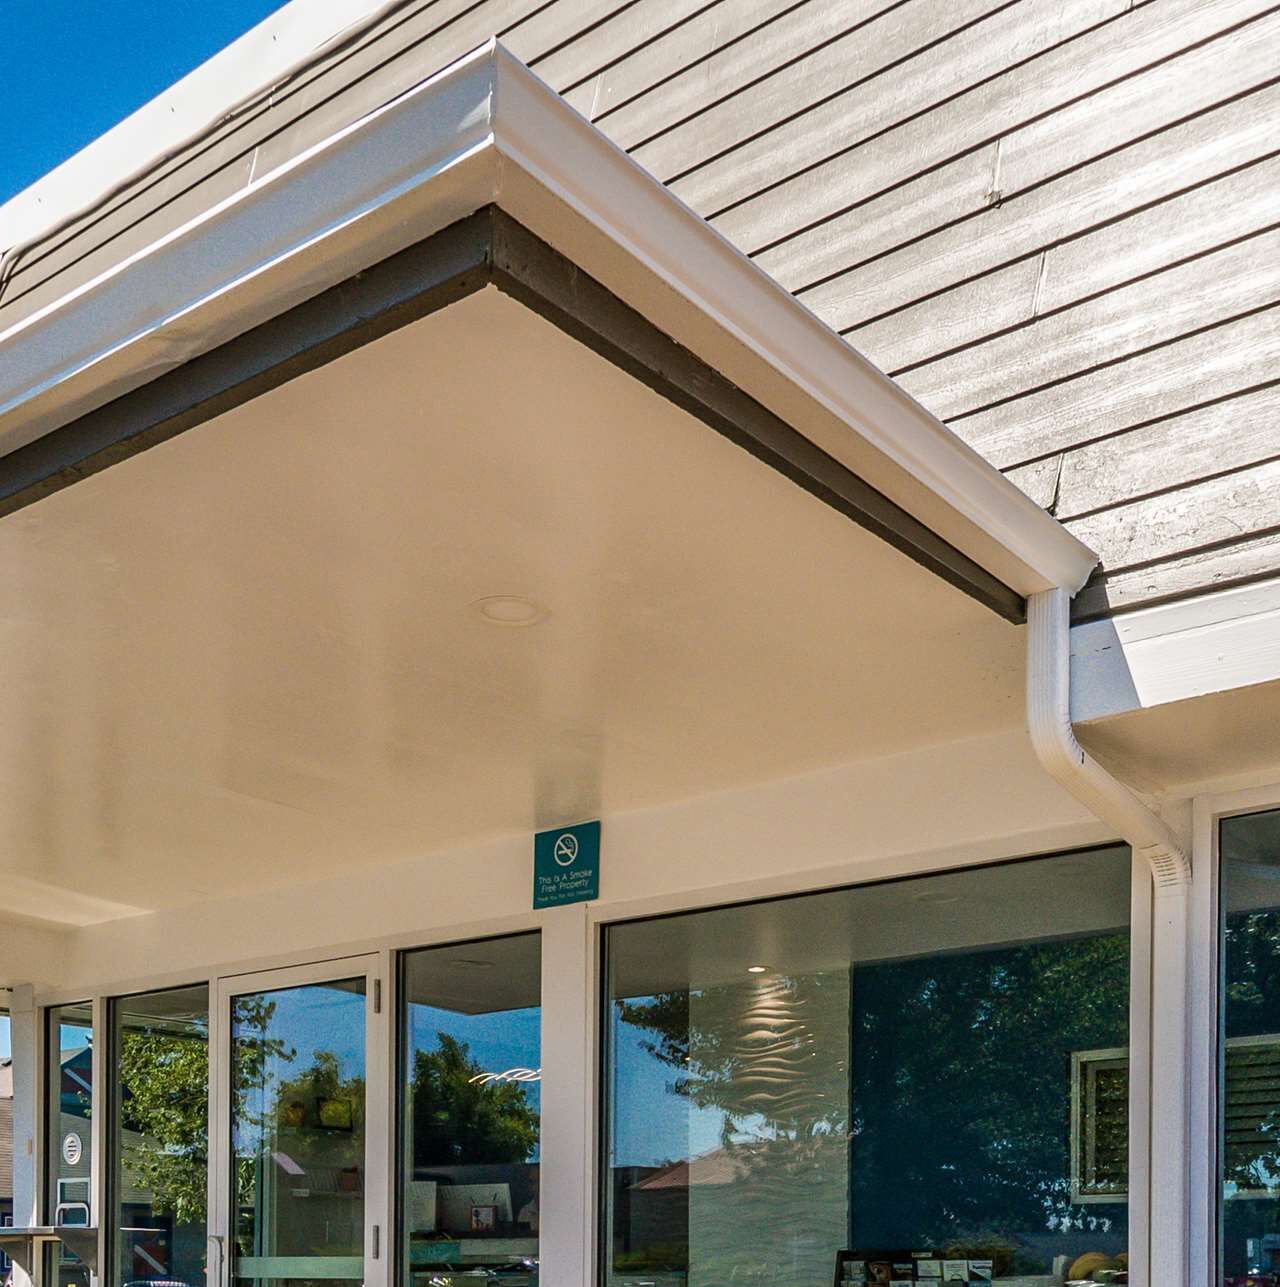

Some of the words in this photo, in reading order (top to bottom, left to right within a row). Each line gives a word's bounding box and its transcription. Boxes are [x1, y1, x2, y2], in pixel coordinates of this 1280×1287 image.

[539, 877, 552, 885] This
[570, 869, 593, 880] Smoke
[541, 884, 557, 893] Free
[560, 879, 589, 889] Property
